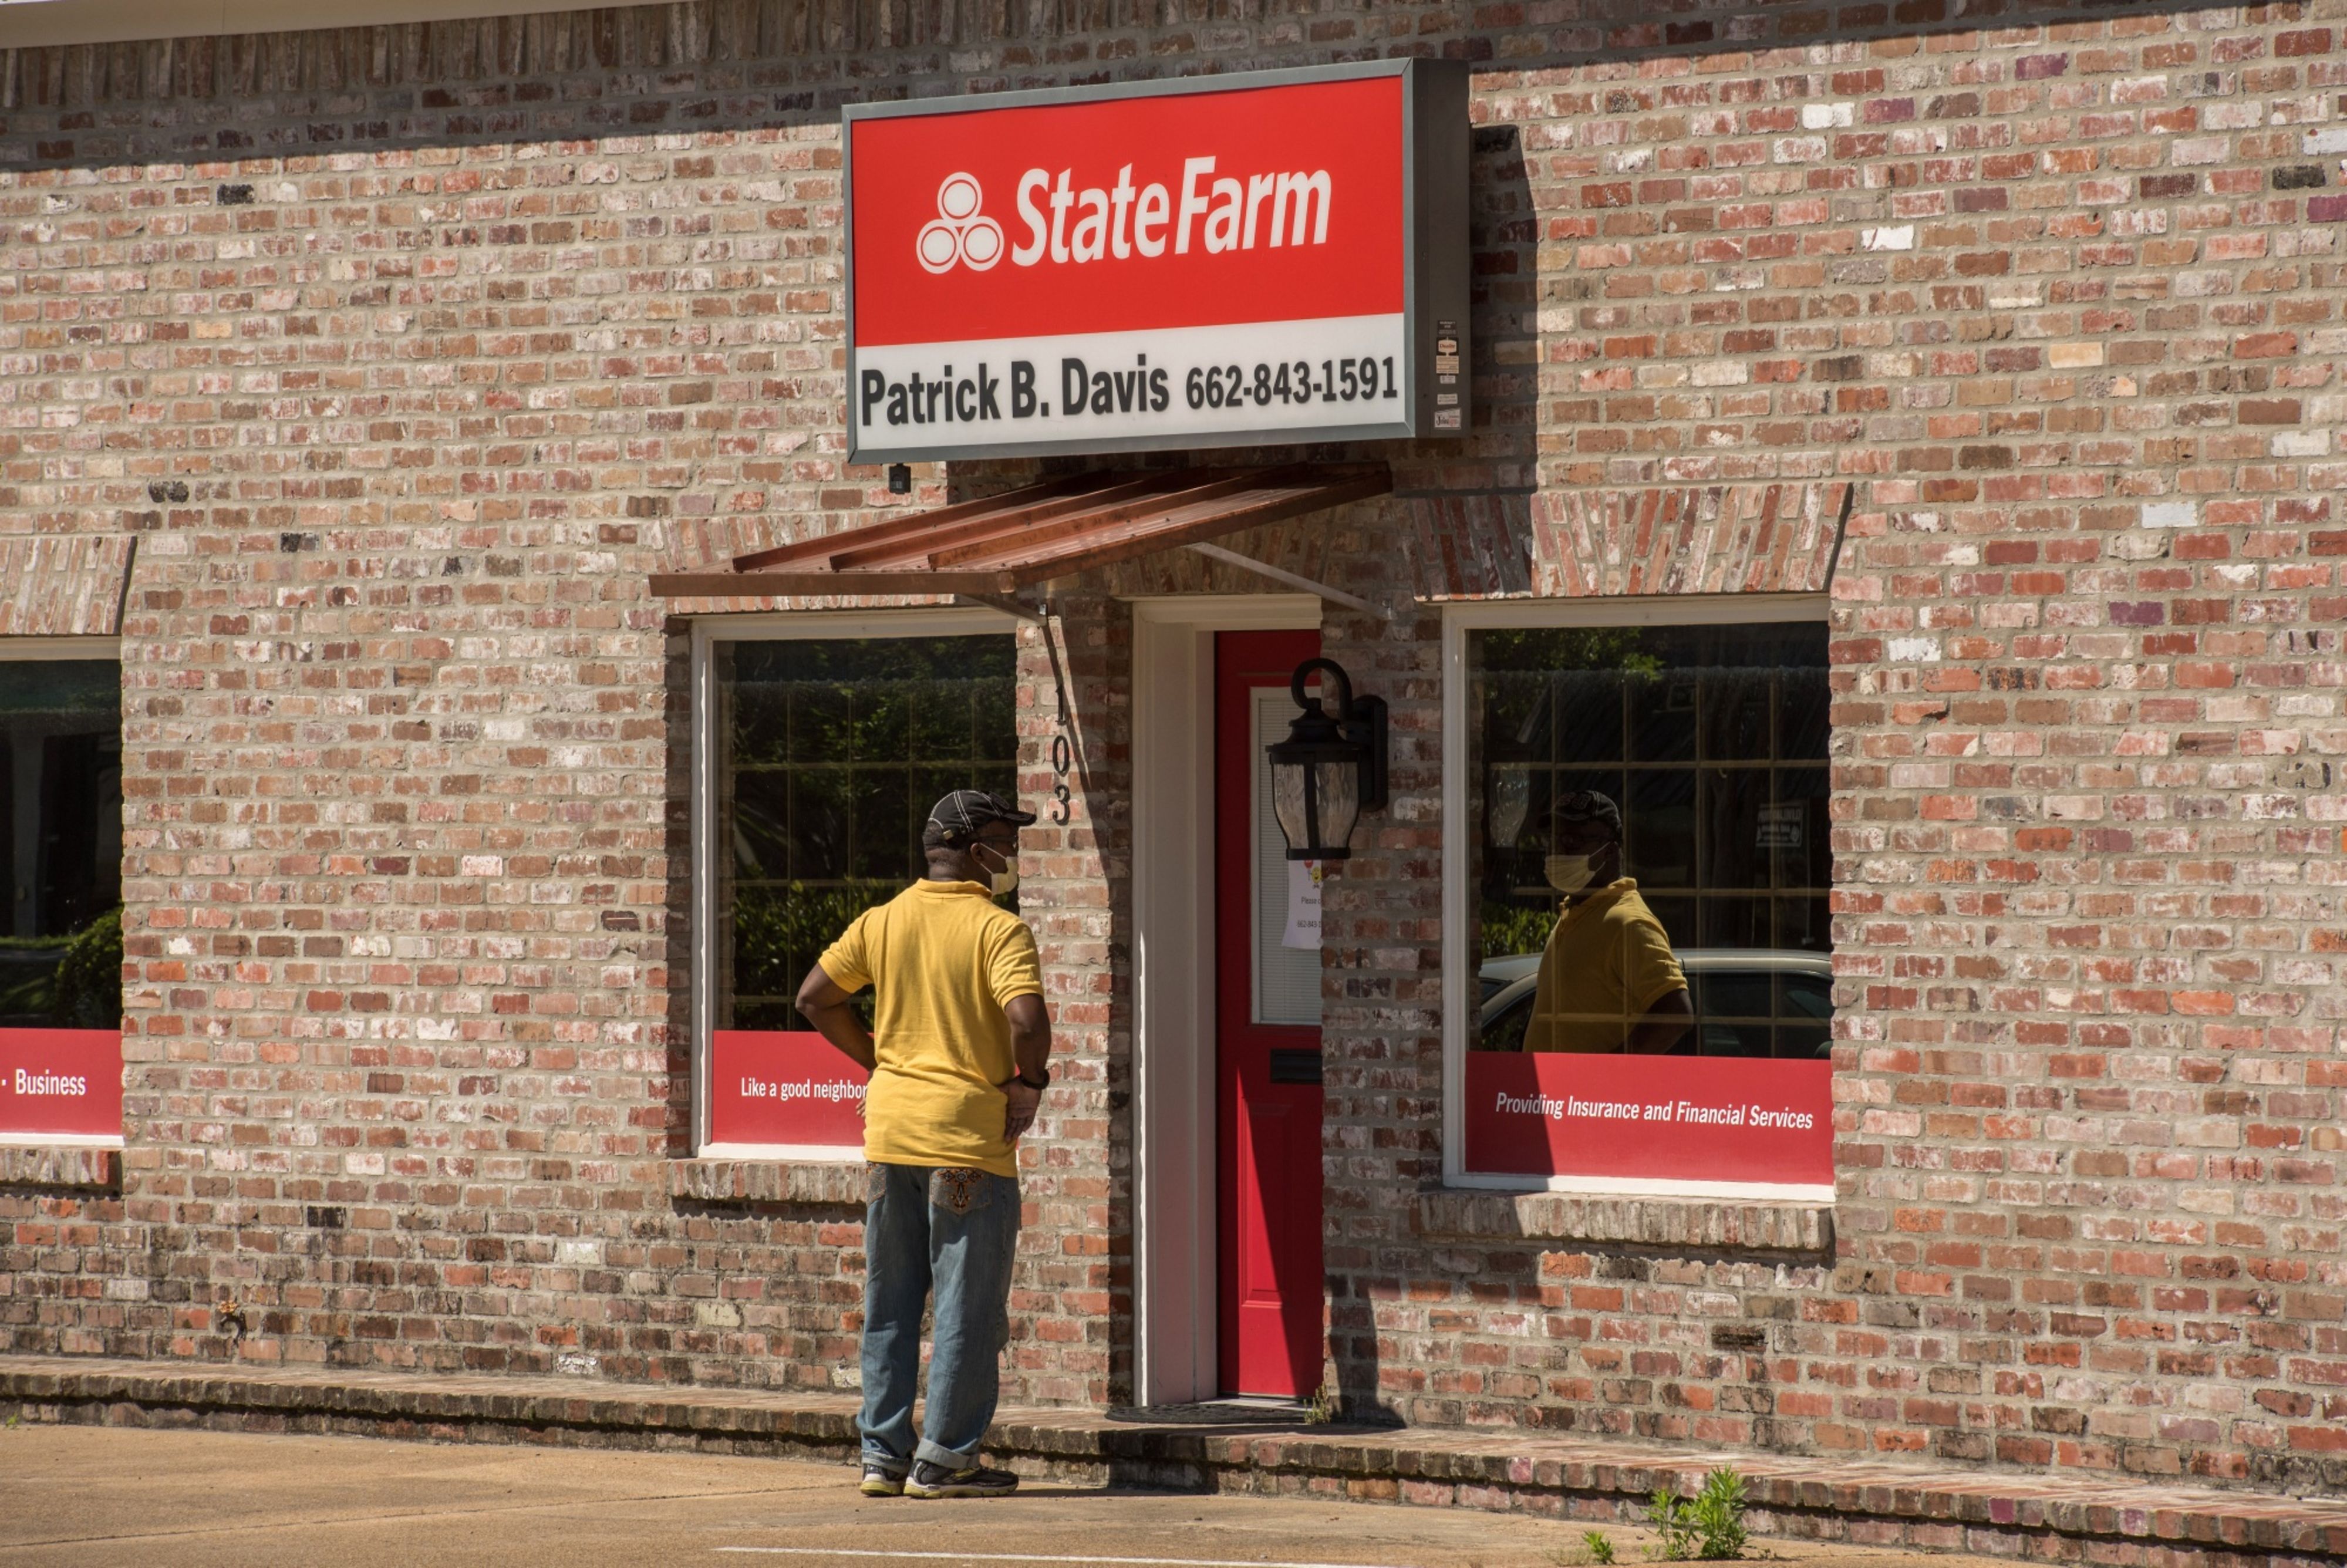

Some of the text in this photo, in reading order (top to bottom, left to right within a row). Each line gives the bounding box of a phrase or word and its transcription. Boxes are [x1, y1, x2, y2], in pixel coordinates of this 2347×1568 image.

[861, 353, 1398, 427] Patrick B. Davis 662-843-1591
[1301, 896, 1317, 905] Please
[15, 1068, 86, 1096] Business
[741, 1077, 868, 1103] Like a good neighbor
[1495, 1091, 1814, 1130] Providing Insurance and Financial Services
